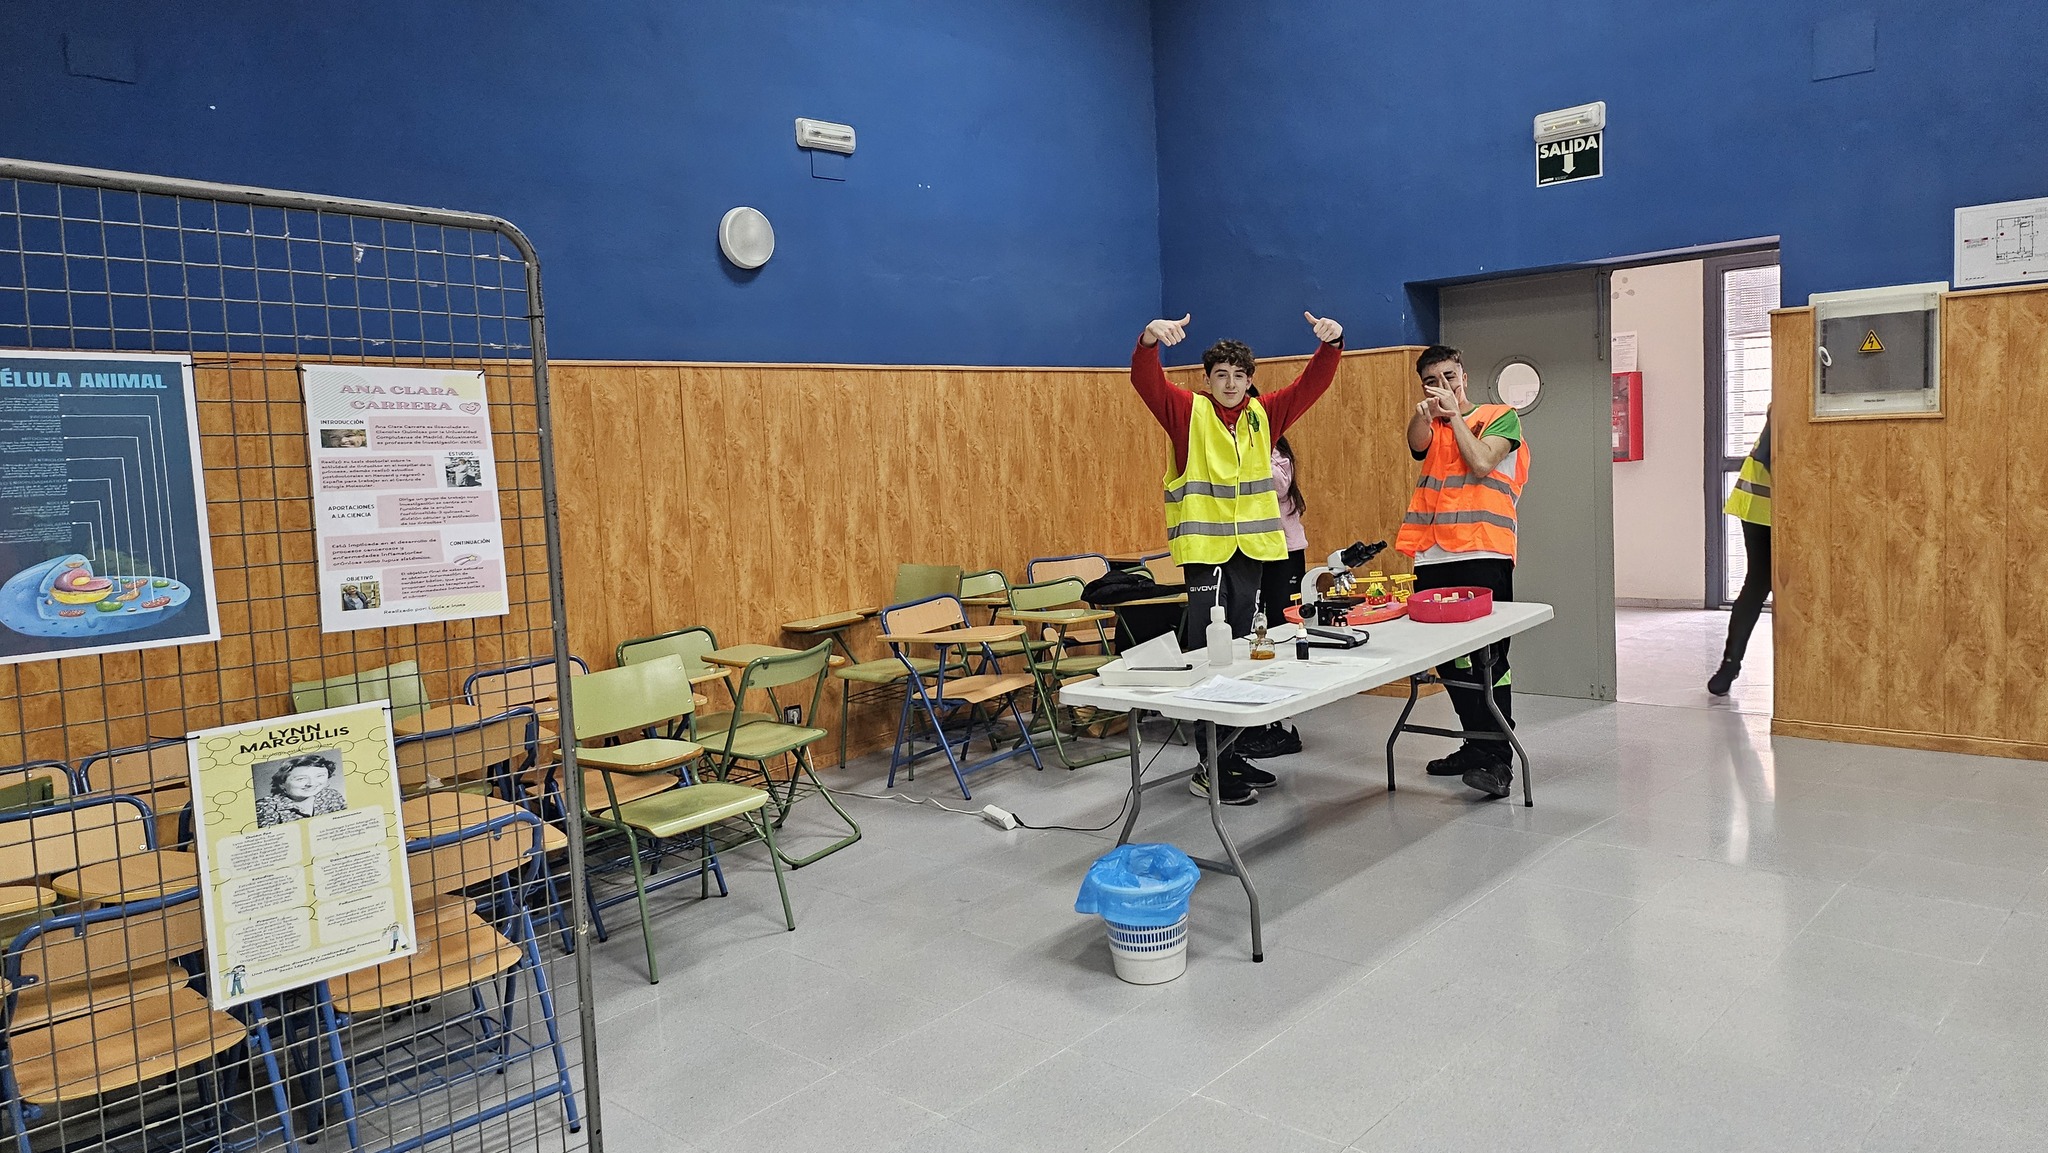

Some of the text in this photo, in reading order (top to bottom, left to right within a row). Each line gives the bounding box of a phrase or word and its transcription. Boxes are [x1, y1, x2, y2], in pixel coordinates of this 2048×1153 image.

[1540, 136, 1598, 158] SALIDA
[80, 373, 167, 388] ANIMAL
[340, 384, 459, 396] ANA CLARA
[350, 400, 452, 410] CARRERA
[269, 723, 320, 740] LYNN
[240, 727, 349, 753] MARGULLIS
